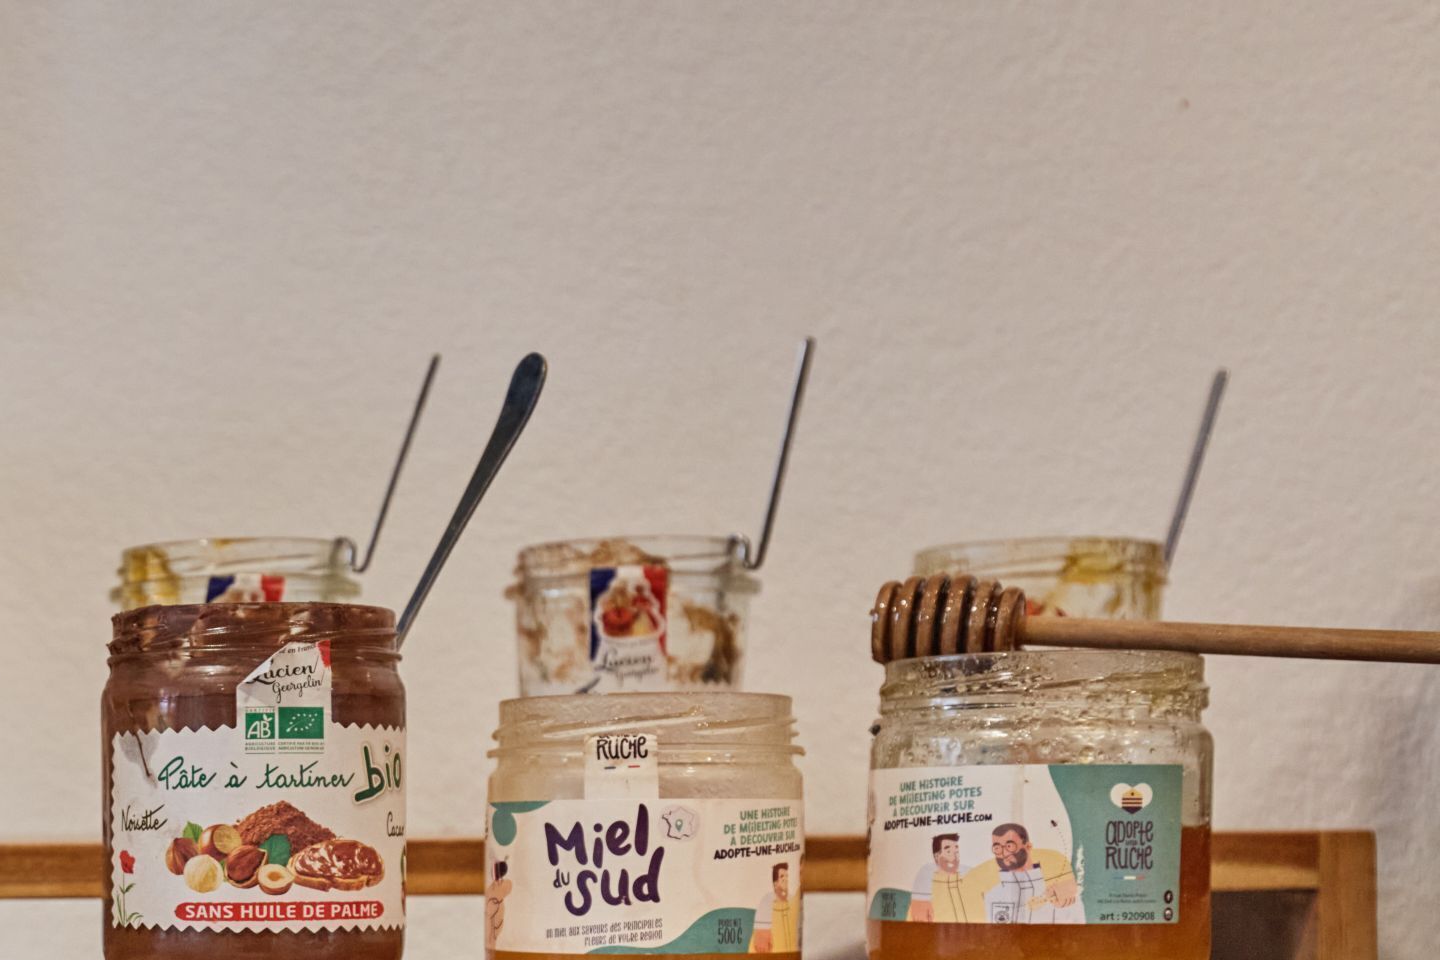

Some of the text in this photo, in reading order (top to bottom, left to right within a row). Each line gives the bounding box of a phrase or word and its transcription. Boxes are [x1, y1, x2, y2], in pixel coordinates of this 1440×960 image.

[272, 672, 324, 704] Georgelin
[247, 719, 271, 739] AB
[158, 745, 402, 803] Pâte à tartiner bio
[900, 781, 916, 792] UNE
[949, 786, 983, 799] POTES
[954, 799, 975, 812] SUR
[121, 804, 168, 832] Noisette
[740, 809, 758, 821] UNE
[544, 803, 649, 869] Miel
[723, 824, 736, 834] DE
[553, 868, 570, 888] du
[185, 903, 378, 919] SANS HUILE DE PALME
[1100, 912, 1115, 921] art
[1121, 911, 1156, 921] 920908
